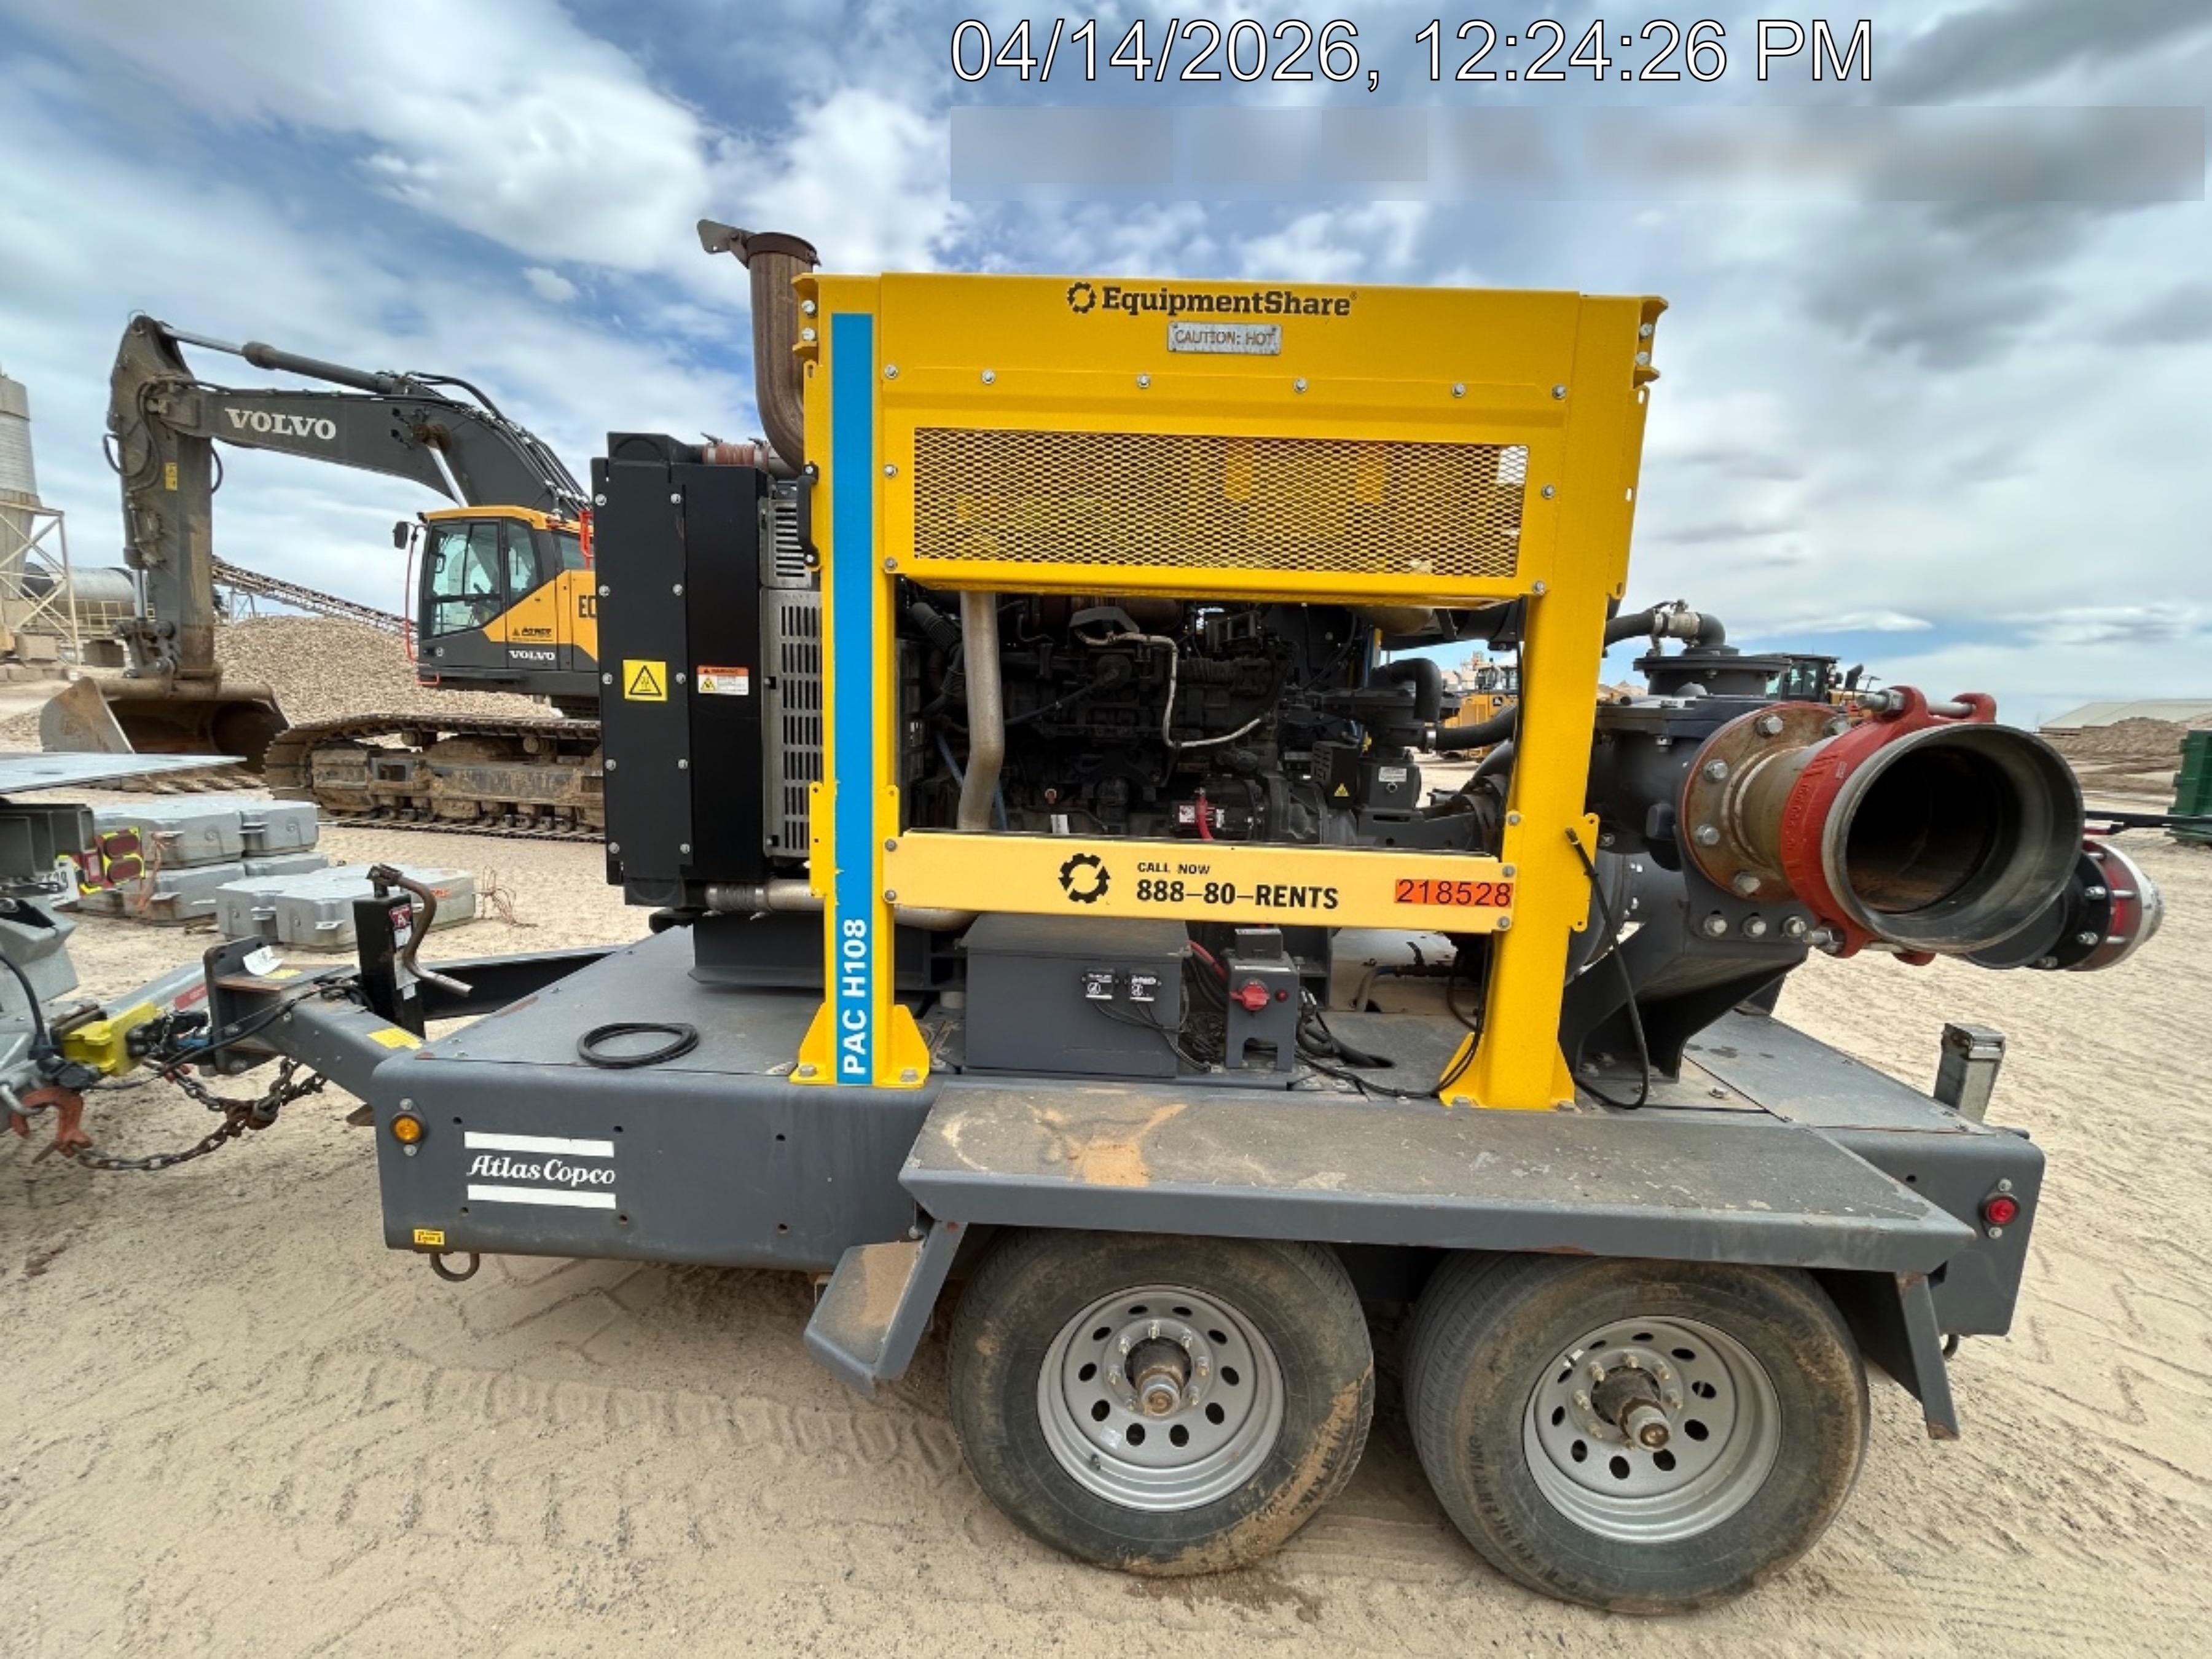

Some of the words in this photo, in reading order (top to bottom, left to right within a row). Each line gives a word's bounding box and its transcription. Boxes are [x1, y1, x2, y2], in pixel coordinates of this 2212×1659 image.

[1175, 329, 1241, 345] CAUTION:
[1245, 331, 1275, 345] HOT
[224, 407, 336, 439] VOLVO
[509, 650, 555, 661] VOLVO
[1137, 862, 1170, 873] CALL
[1178, 863, 1210, 874] NOW
[1137, 879, 1338, 909] 888-80-RENTS
[1397, 879, 1511, 908] 218528
[842, 919, 867, 998] H108
[842, 1010, 867, 1075] PAC
[466, 1155, 541, 1180] Atlas
[543, 1158, 616, 1188] Copco
